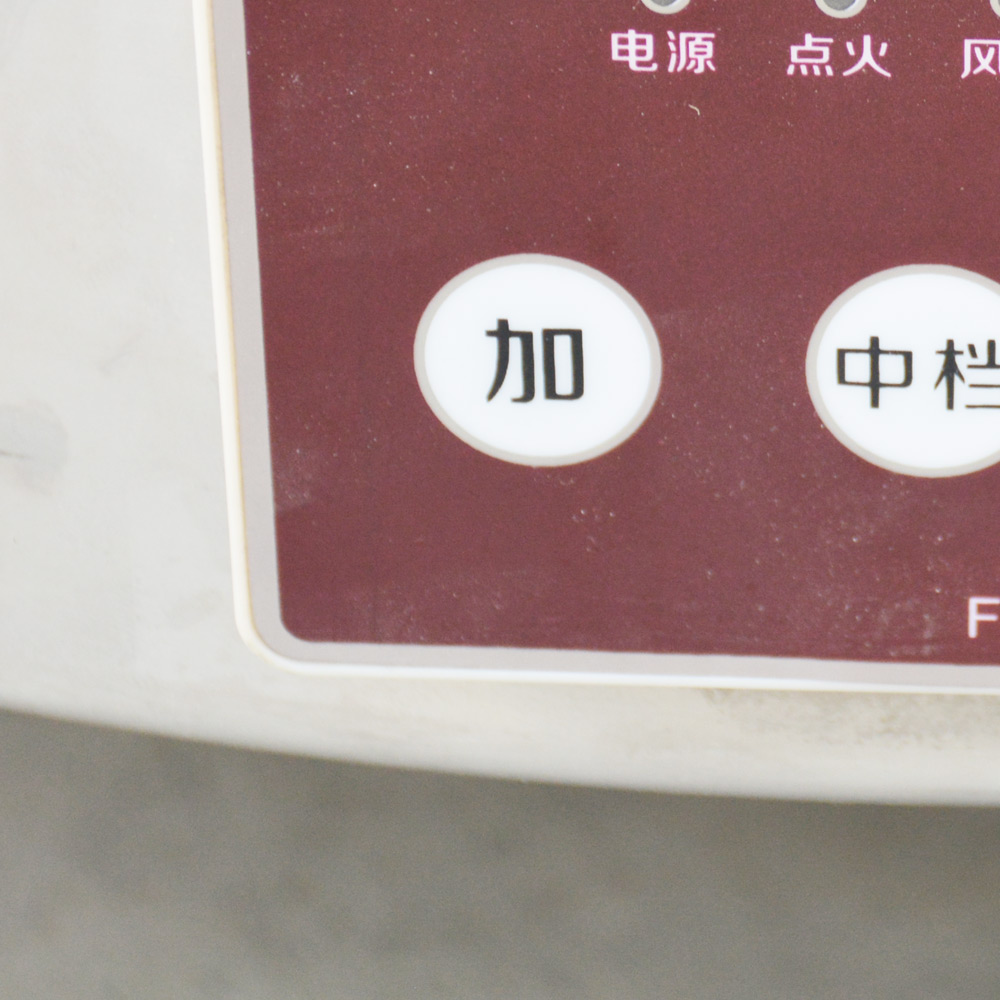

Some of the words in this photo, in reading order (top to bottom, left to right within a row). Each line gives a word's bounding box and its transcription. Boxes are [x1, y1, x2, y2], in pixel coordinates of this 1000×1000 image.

[611, 29, 717, 75] 电源
[785, 33, 892, 79] 点火
[486, 319, 583, 403] 加
